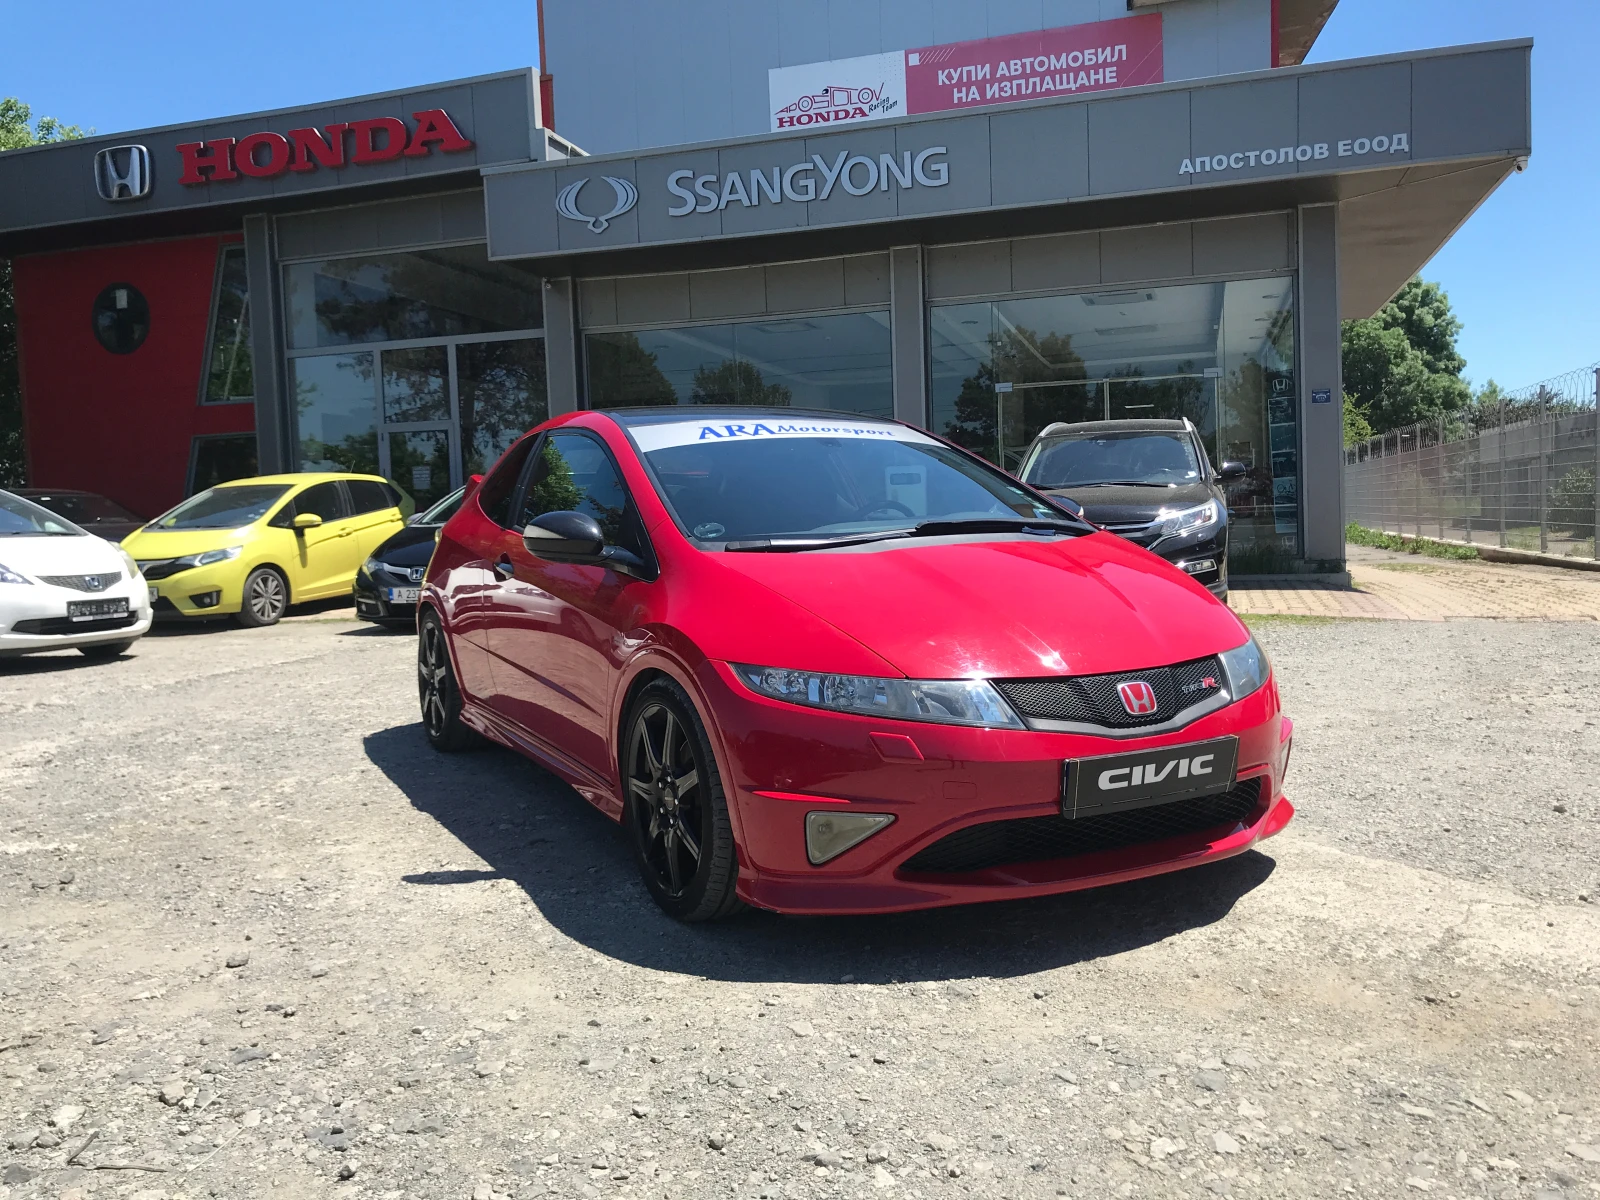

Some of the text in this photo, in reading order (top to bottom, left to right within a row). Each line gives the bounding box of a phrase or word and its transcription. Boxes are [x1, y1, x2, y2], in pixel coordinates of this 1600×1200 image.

[938, 44, 1127, 85] КУПИ АВТОМОБИЛ
[953, 67, 1117, 103] НА ИЗПЛАЩАНЕ
[777, 107, 869, 128] HONDA
[868, 96, 889, 113] Racing
[882, 100, 897, 113] Team
[176, 108, 474, 185] HONDA
[1178, 133, 1409, 175] АПОСТОЛОВ ЕООД
[699, 423, 895, 439] ARA Motorsport
[397, 590, 403, 598] A
[1098, 754, 1214, 790] CIVIC
